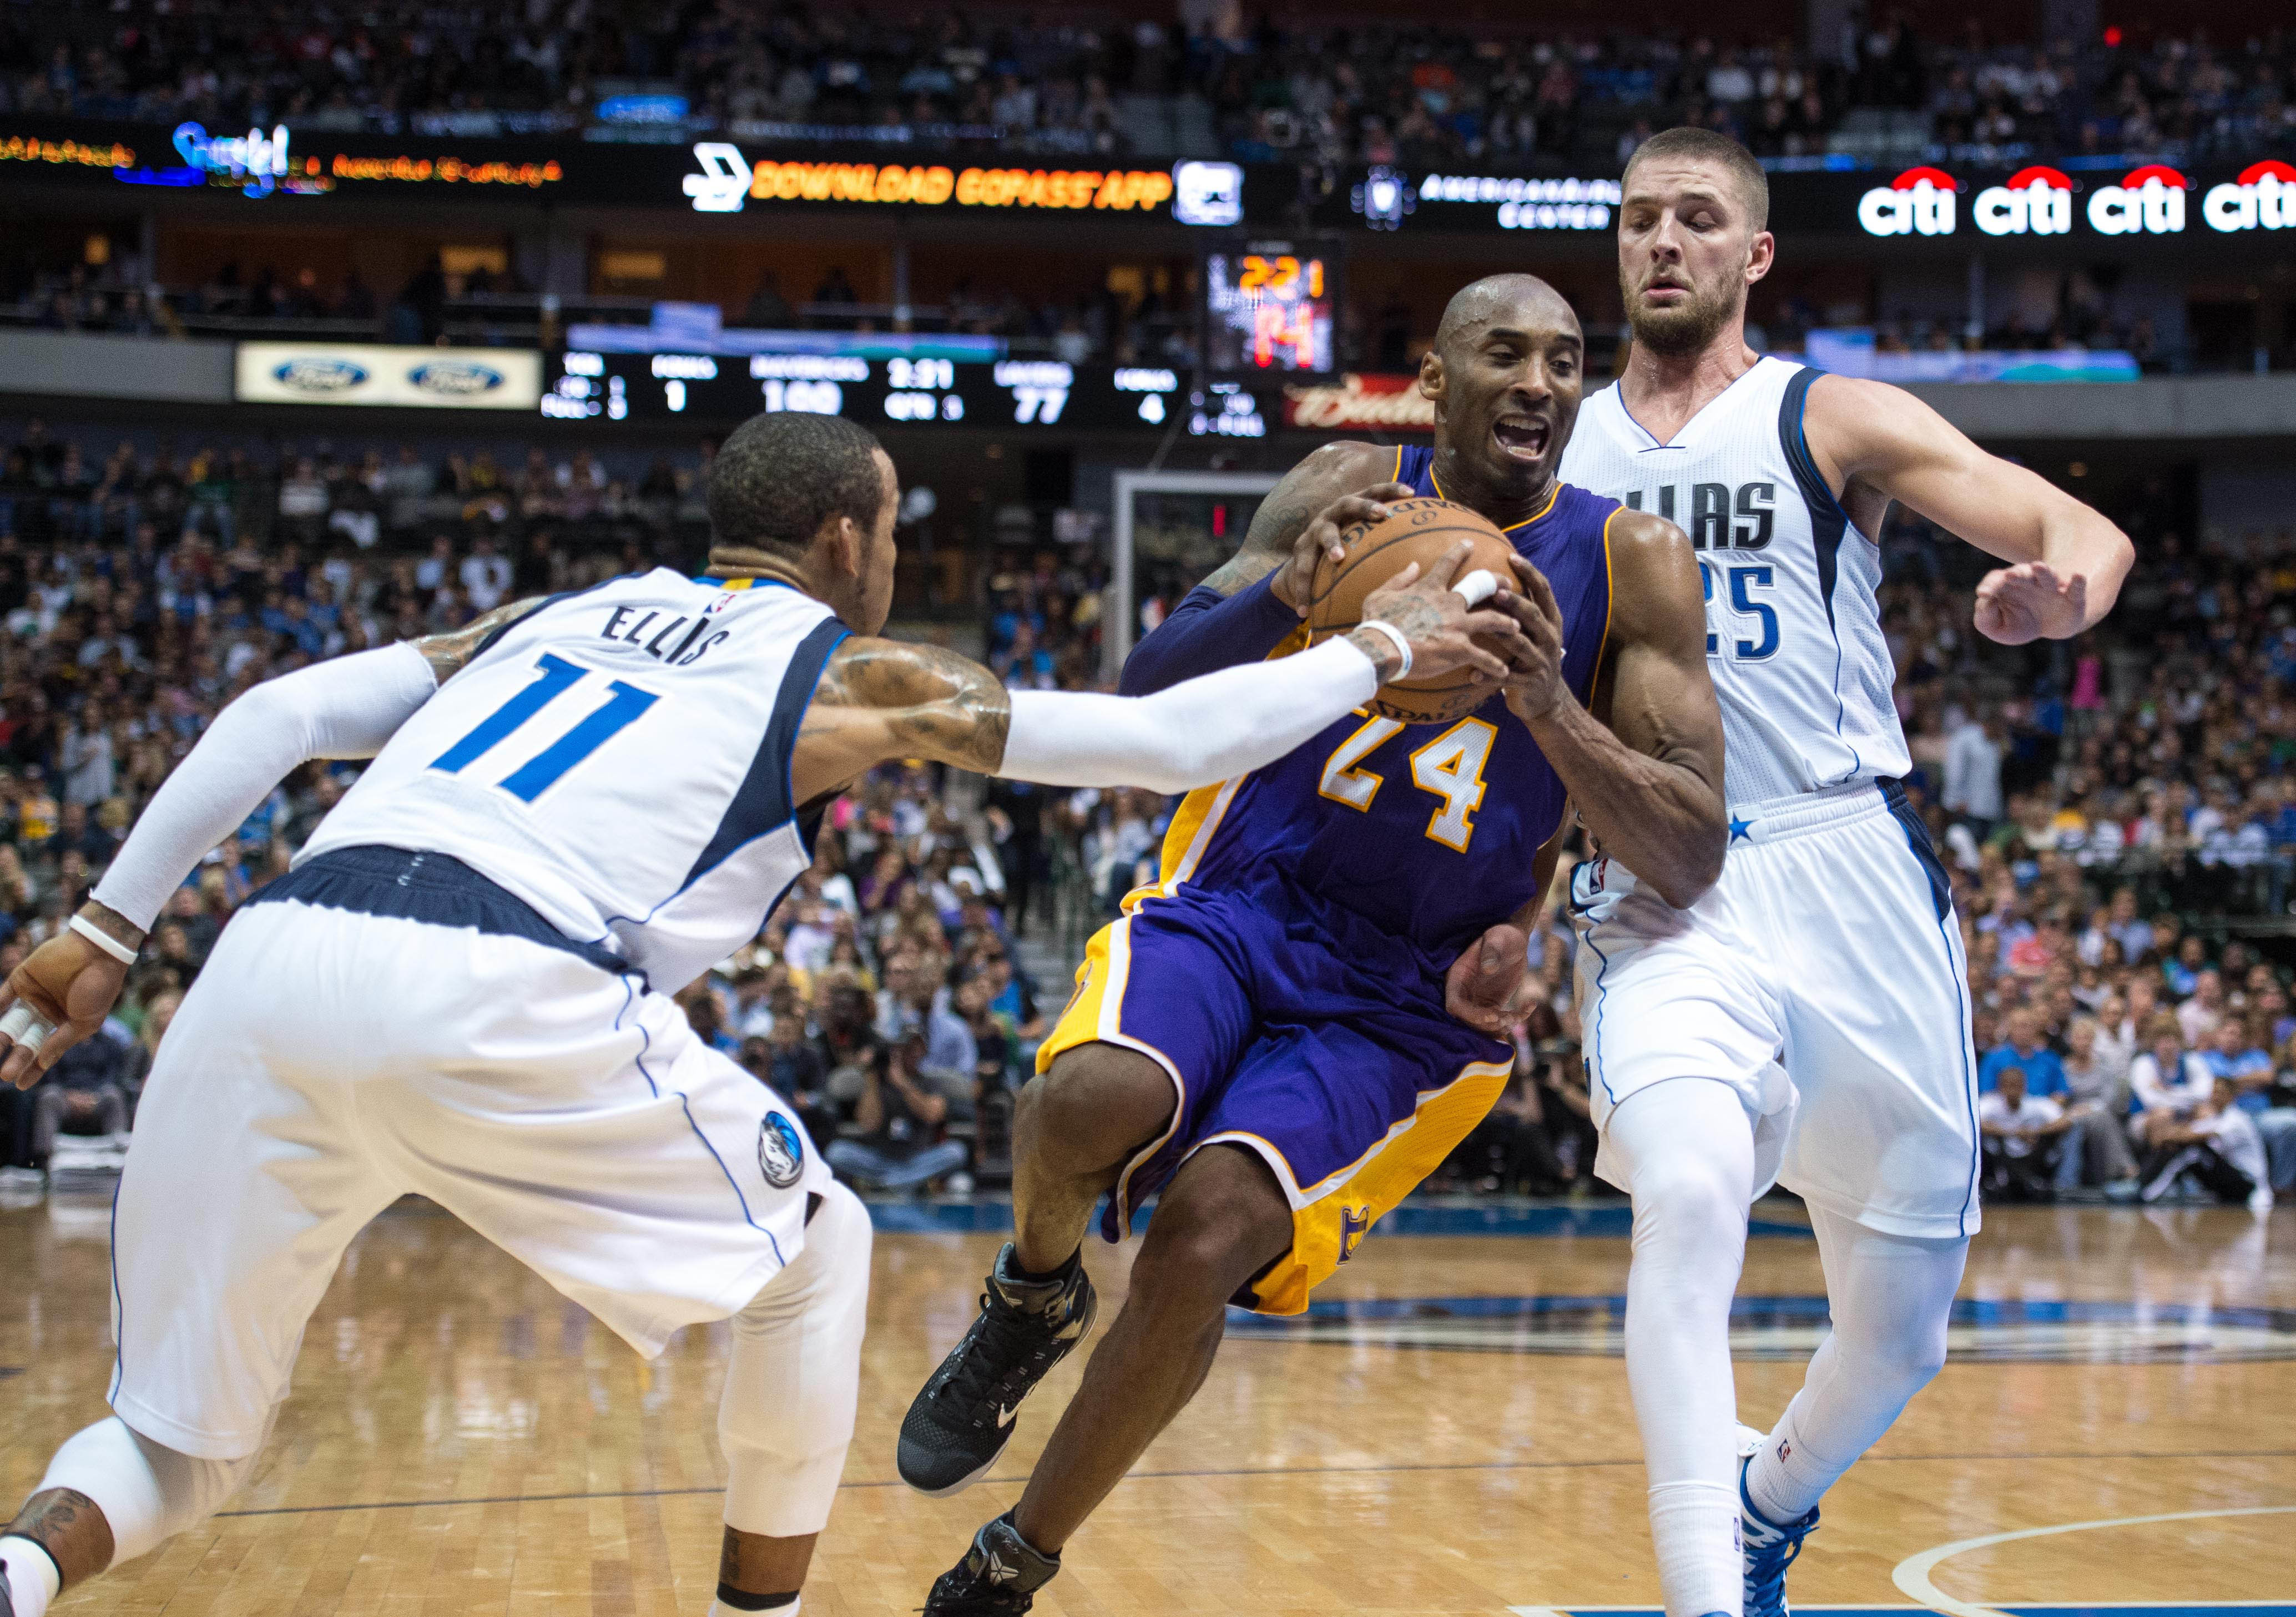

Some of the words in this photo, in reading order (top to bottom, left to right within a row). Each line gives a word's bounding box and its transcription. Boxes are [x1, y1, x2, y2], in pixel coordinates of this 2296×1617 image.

[750, 160, 954, 204] DOWNLOAD
[1093, 170, 1173, 211] APP
[1858, 178, 1956, 236] citi
[1973, 178, 2072, 235] citi
[2087, 176, 2186, 235] citi
[1013, 387, 1069, 423] 77
[601, 605, 730, 666] ELLIS
[424, 650, 662, 804] 11
[1318, 707, 1498, 854] 24
